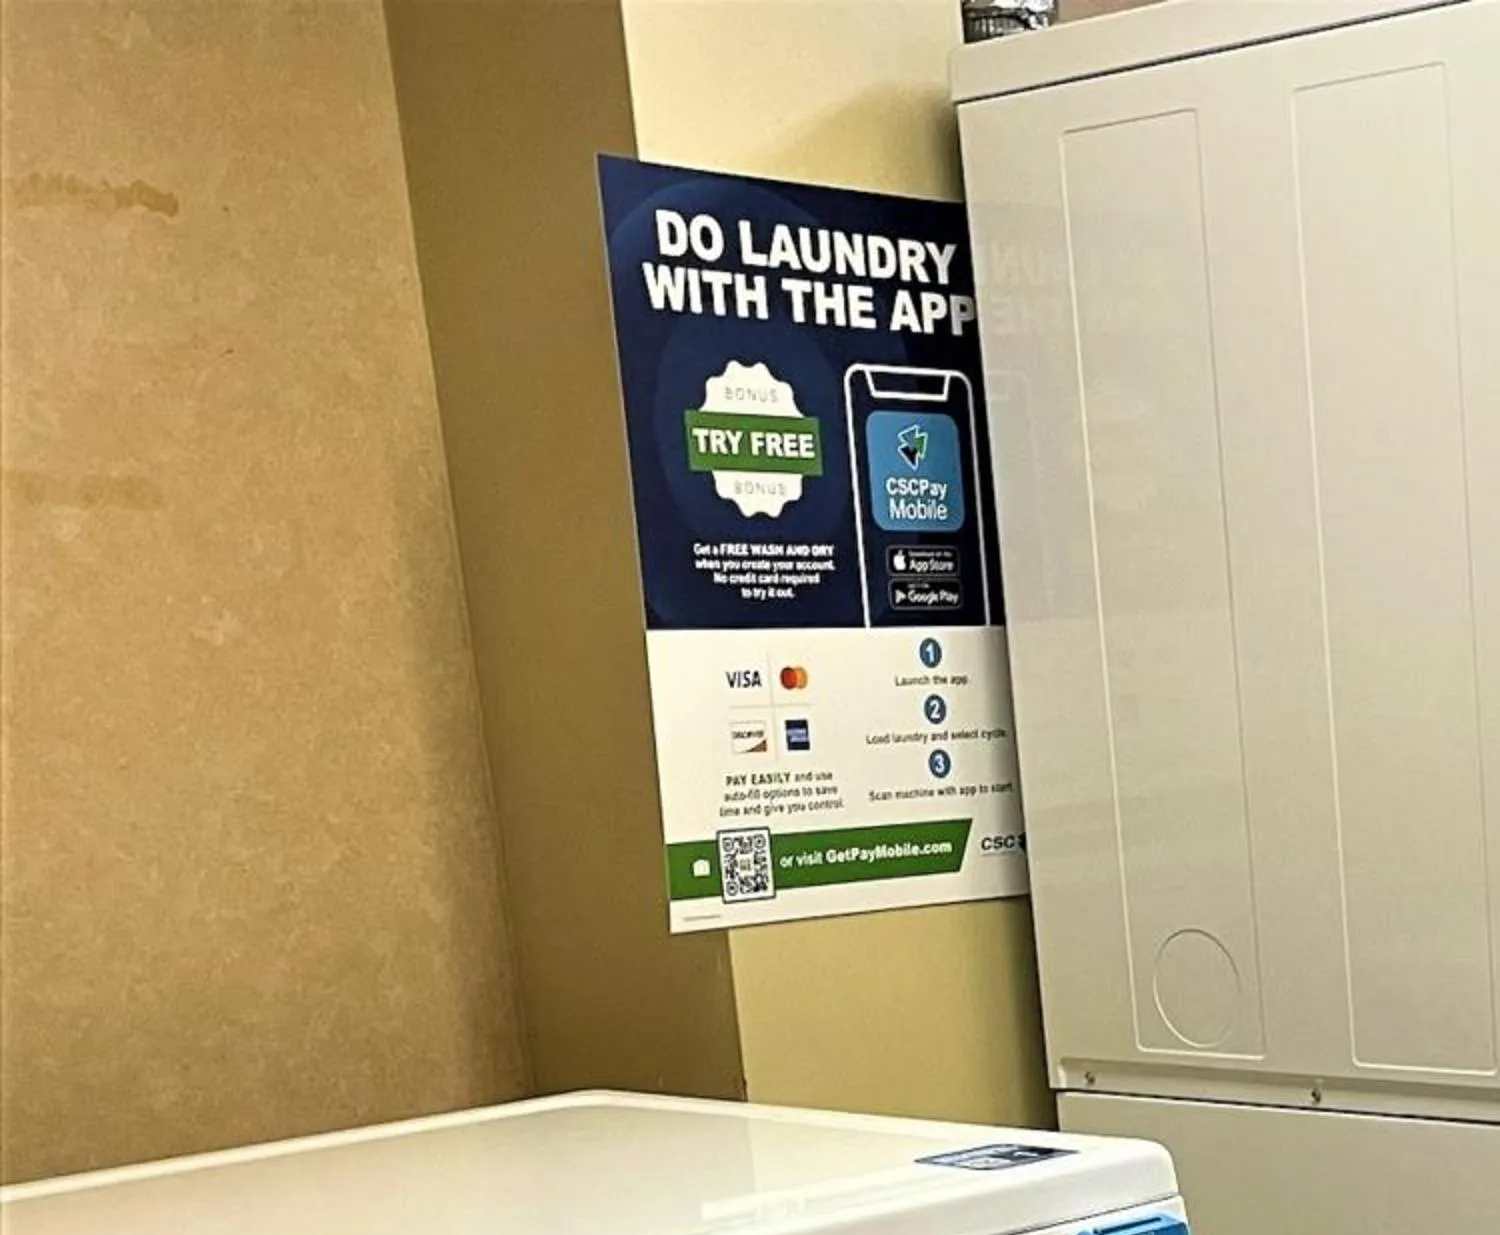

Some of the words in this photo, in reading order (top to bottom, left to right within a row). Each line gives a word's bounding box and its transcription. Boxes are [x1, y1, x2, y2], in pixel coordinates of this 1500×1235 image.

[655, 208, 724, 262] DO
[738, 219, 957, 285] LAUNDRY
[642, 262, 769, 320] WITH
[781, 277, 877, 330] THE
[889, 290, 975, 336] APP
[724, 387, 778, 402] BONUS
[691, 427, 743, 455] TRY
[750, 431, 816, 458] FREE
[734, 480, 787, 495] BONUS
[886, 477, 947, 500] CSCPay
[889, 498, 948, 520] Mobile
[720, 543, 748, 556] FREE
[926, 643, 934, 663] 1
[725, 670, 762, 688] VISA
[895, 676, 930, 687] Launch
[932, 675, 947, 684] the
[930, 700, 940, 719] 2
[866, 734, 890, 745] Load
[892, 732, 928, 744] laundry
[930, 730, 948, 741] and
[934, 754, 946, 774] 3
[726, 774, 746, 786] PAY
[751, 772, 791, 785] EASILY
[794, 772, 813, 782] and
[868, 790, 893, 801] Scan
[895, 787, 934, 800] machine
[936, 786, 958, 796] with
[960, 785, 977, 796] app
[979, 784, 988, 794] to
[743, 805, 762, 816] and
[764, 804, 784, 817] give
[787, 803, 806, 814] you
[981, 835, 1016, 851] CSC
[780, 856, 793, 868] or
[795, 851, 823, 866] visit
[826, 842, 953, 864] GetPayMobile.com
